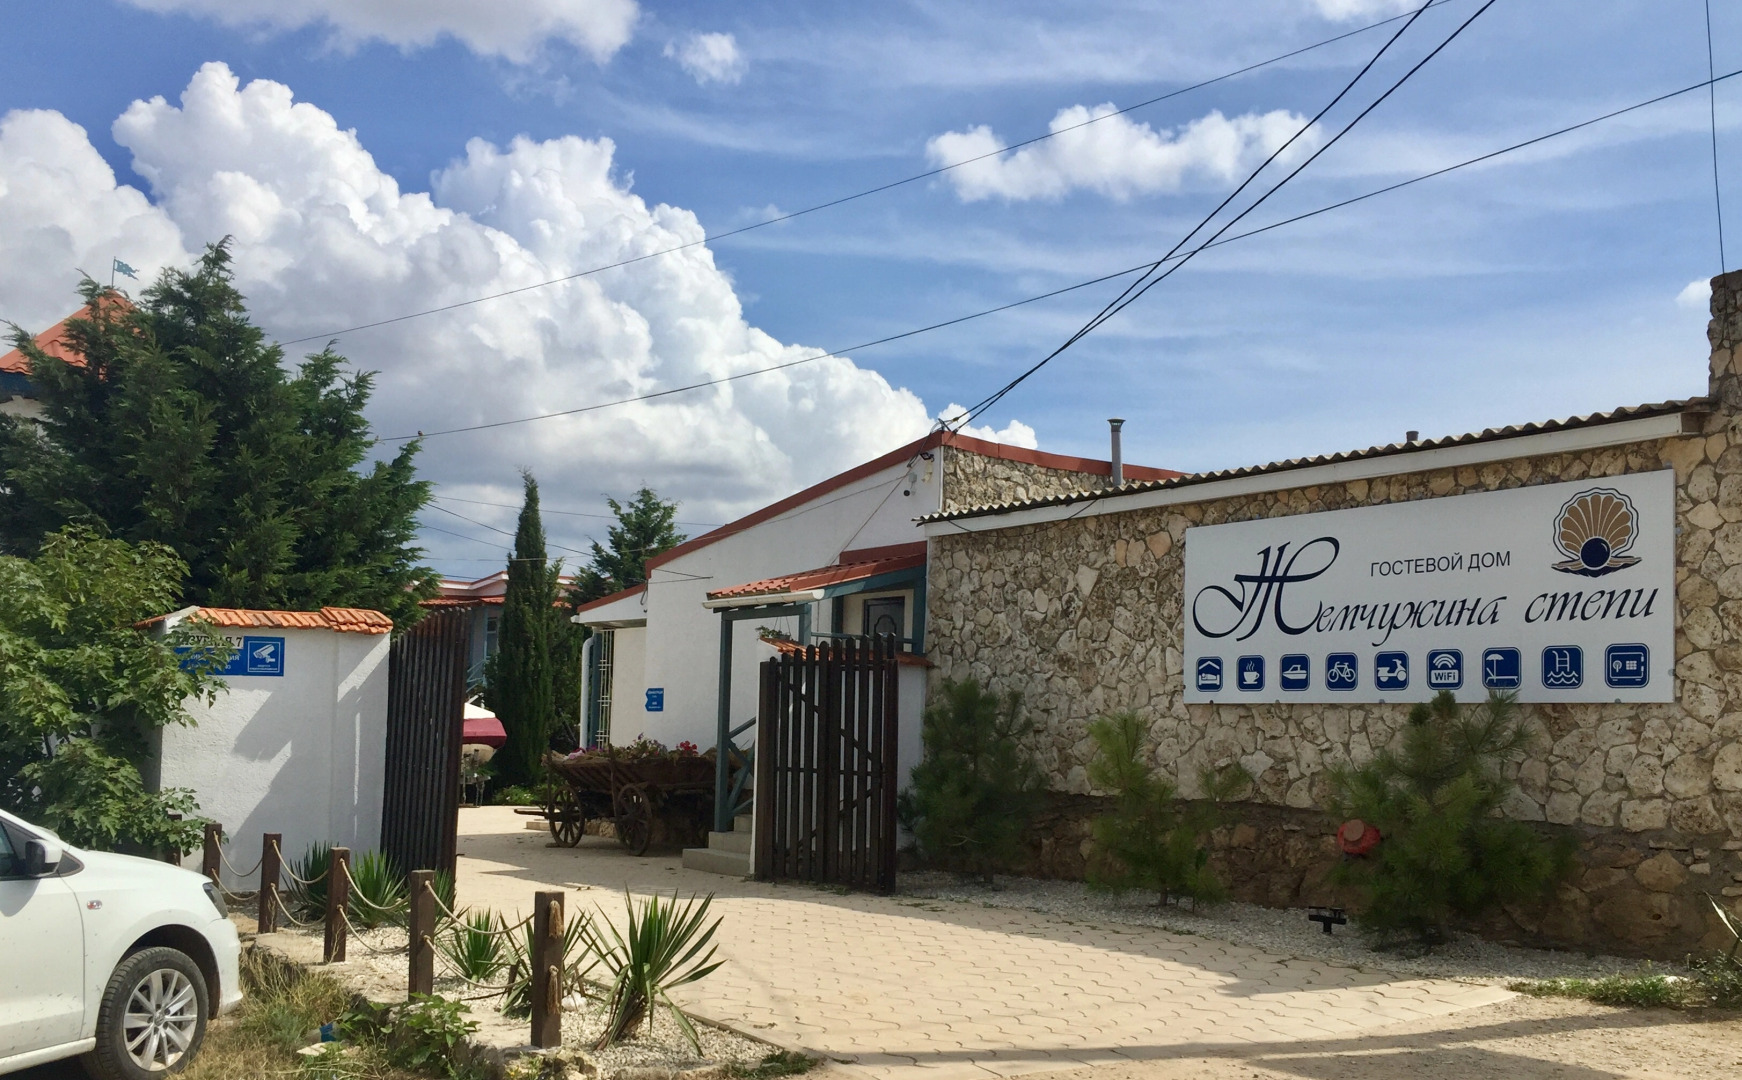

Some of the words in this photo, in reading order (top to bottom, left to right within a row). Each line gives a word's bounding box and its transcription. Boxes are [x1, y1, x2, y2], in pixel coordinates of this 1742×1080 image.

[1370, 552, 1463, 577] ГОСТЕВОЙ
[1467, 551, 1511, 573] ДОМ
[1192, 536, 1507, 647] Жемчужина
[1524, 582, 1659, 624] степи
[236, 636, 243, 647] 7
[1434, 672, 1456, 681] WiFi
